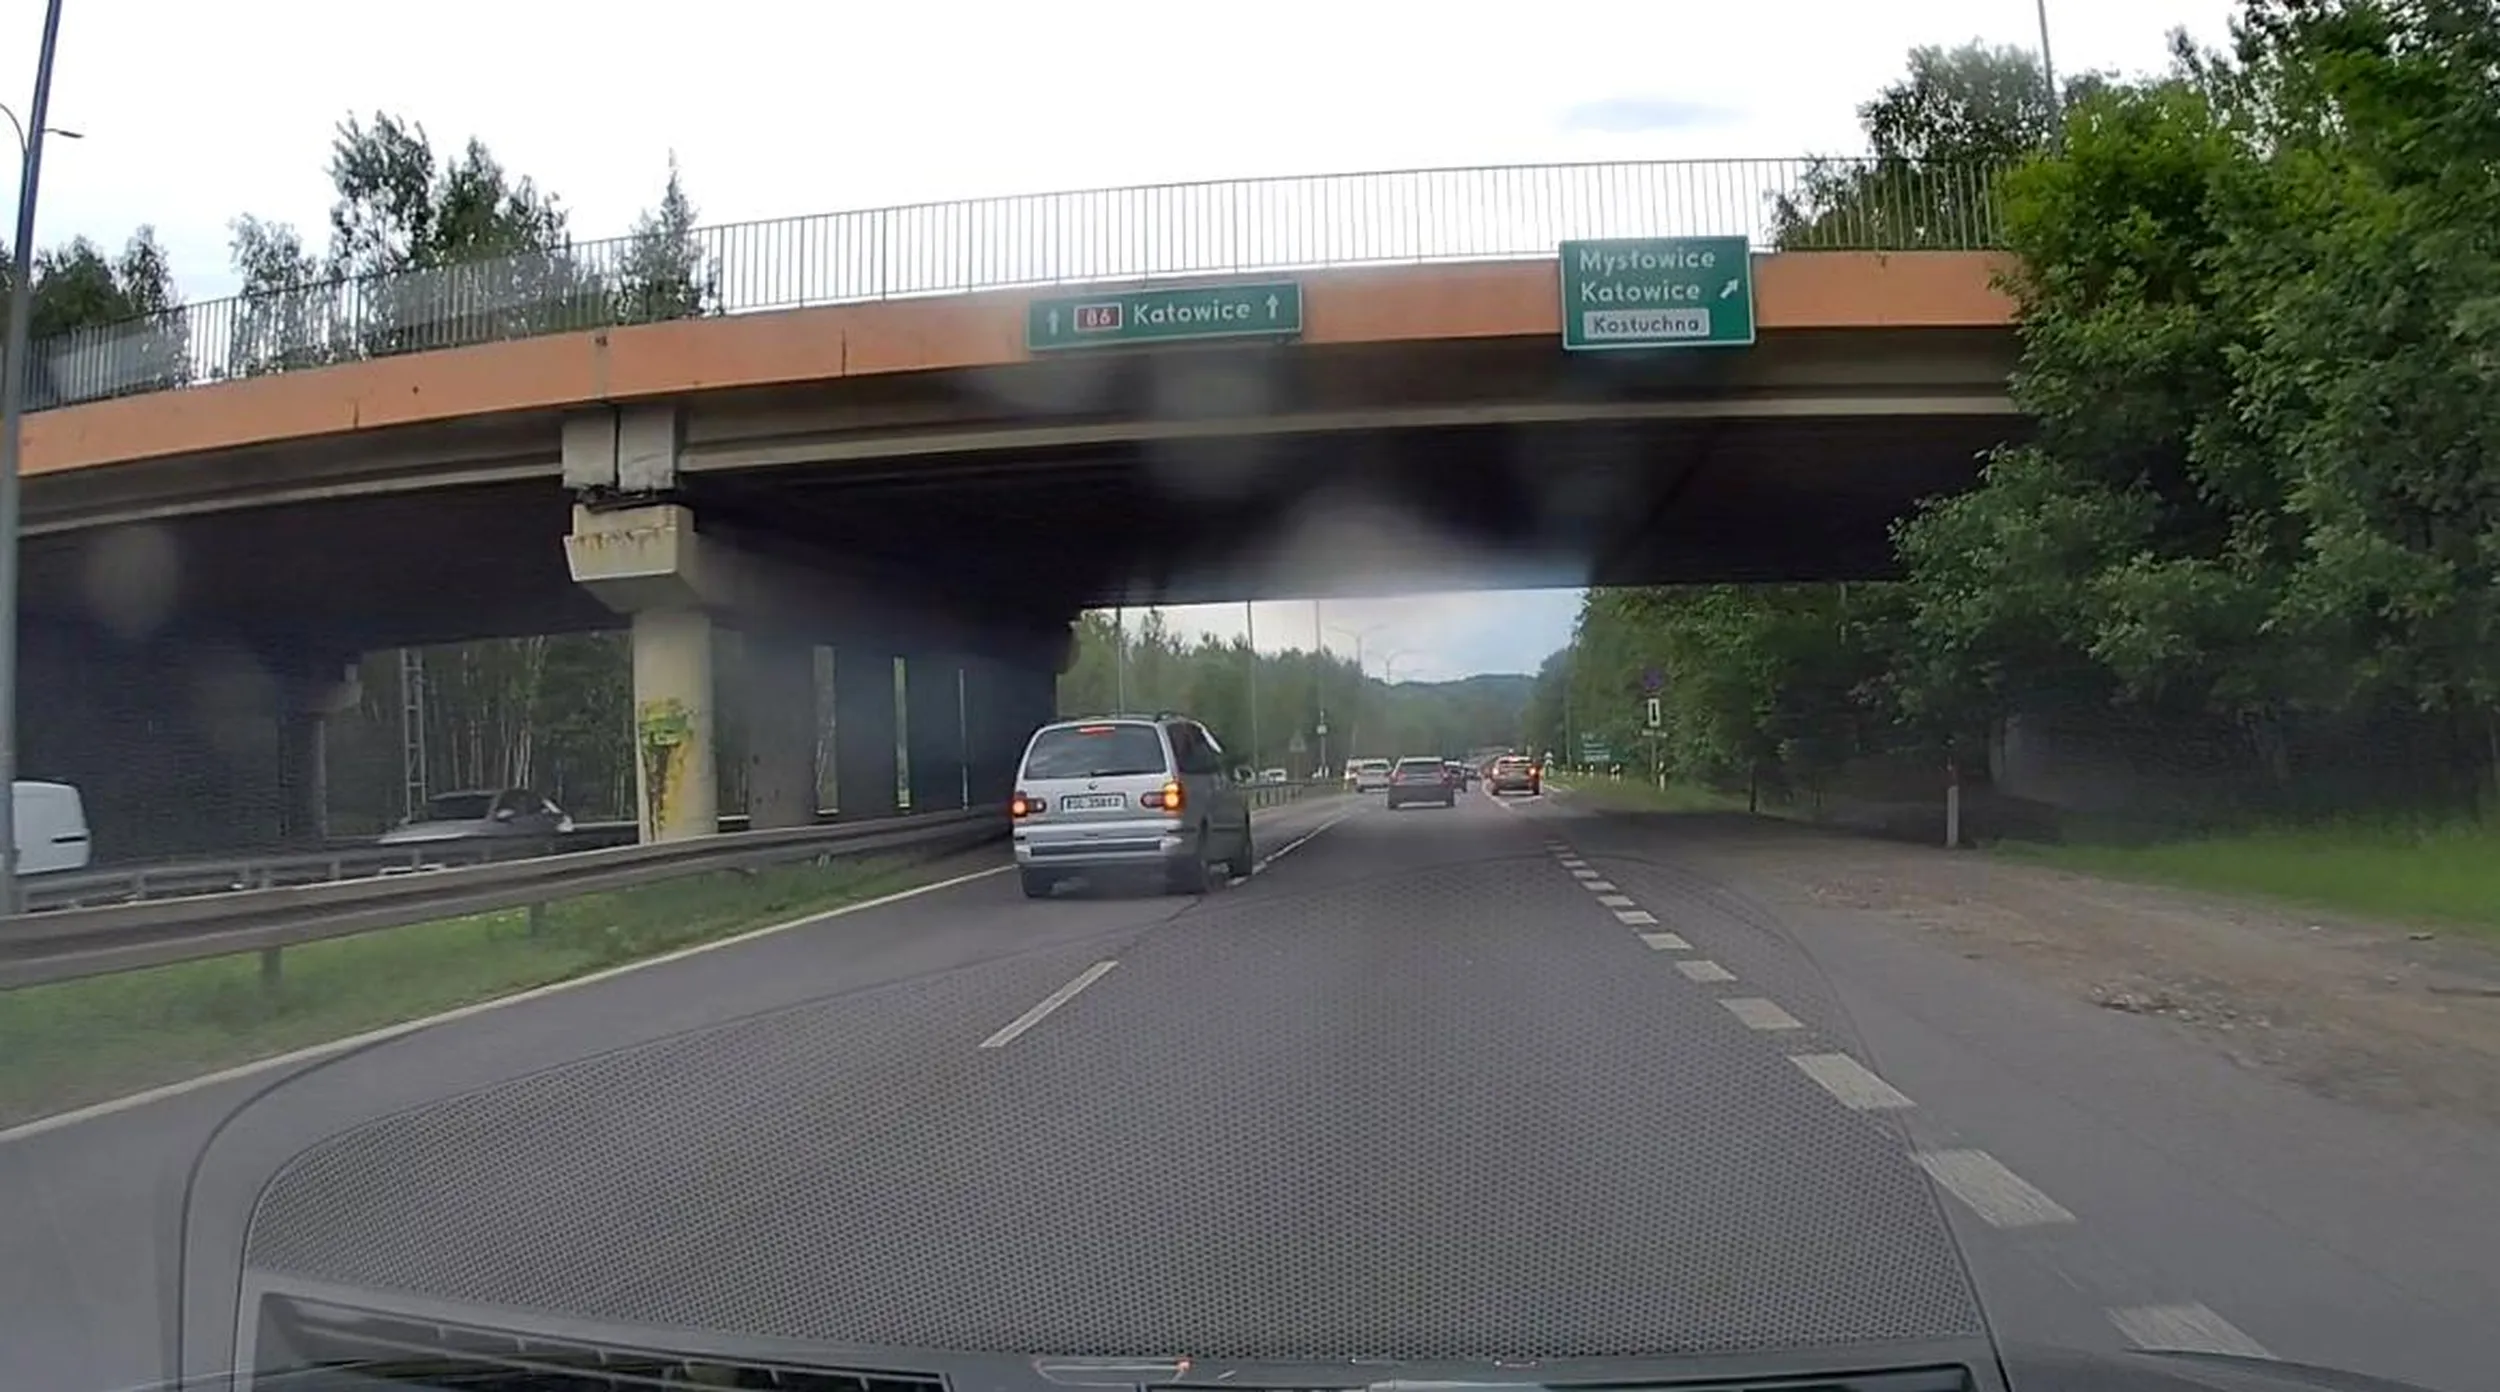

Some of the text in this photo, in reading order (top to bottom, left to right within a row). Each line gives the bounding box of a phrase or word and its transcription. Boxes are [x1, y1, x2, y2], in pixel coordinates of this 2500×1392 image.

[1579, 246, 1716, 276] Mysłowice
[1580, 280, 1701, 303] Katowice
[1133, 299, 1250, 326] Katowice
[1592, 315, 1700, 334] Kostuchna
